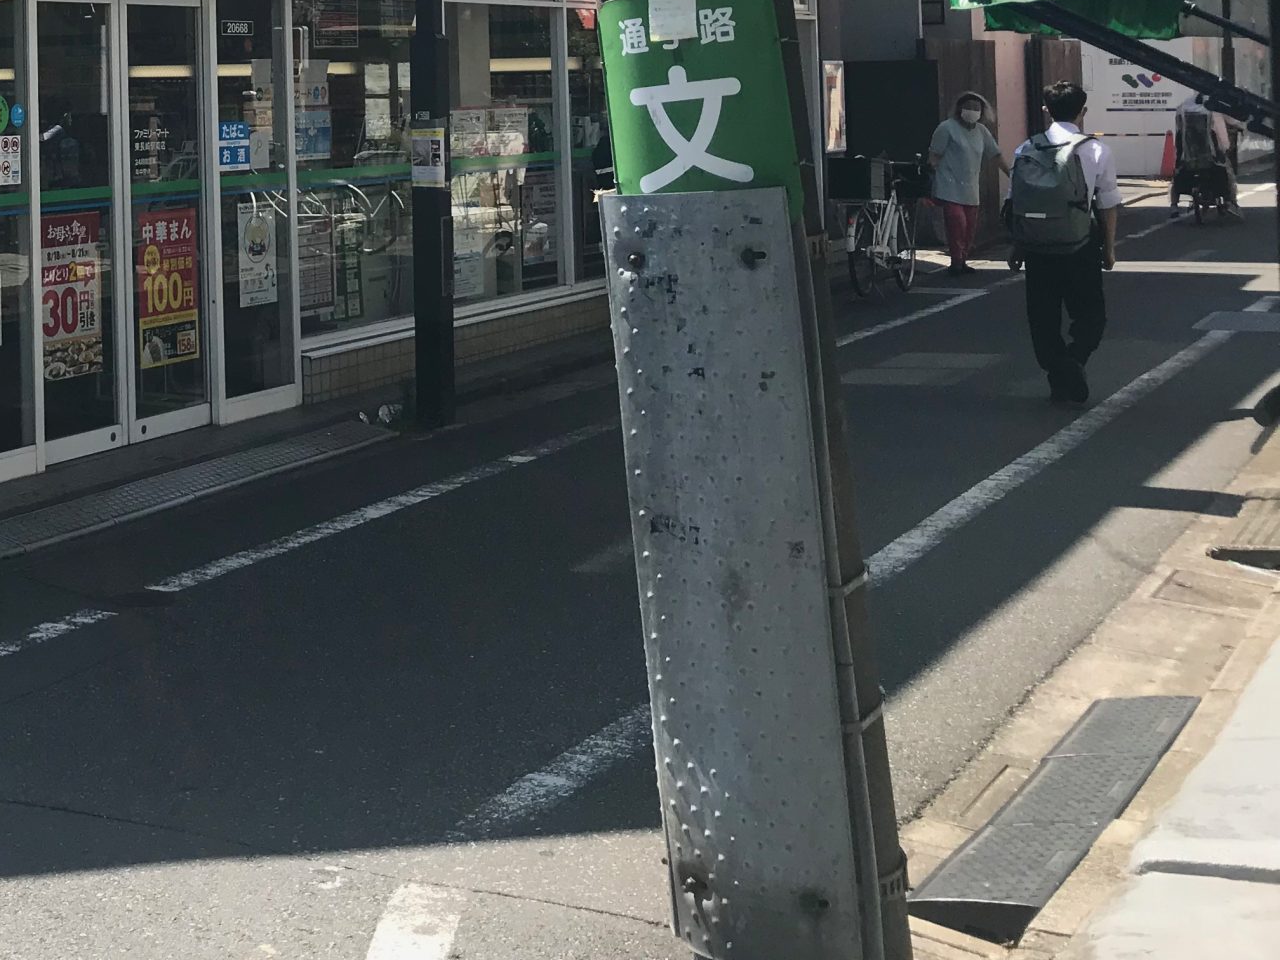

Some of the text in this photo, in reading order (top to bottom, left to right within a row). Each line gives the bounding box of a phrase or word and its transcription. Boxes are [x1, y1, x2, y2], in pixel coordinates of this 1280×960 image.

[618, 6, 736, 56] 通路
[134, 128, 169, 139] ファミリーマート
[222, 124, 245, 138] たばこ
[630, 65, 754, 194] 文
[142, 219, 192, 245] 中華まん
[144, 271, 194, 314] 100円
